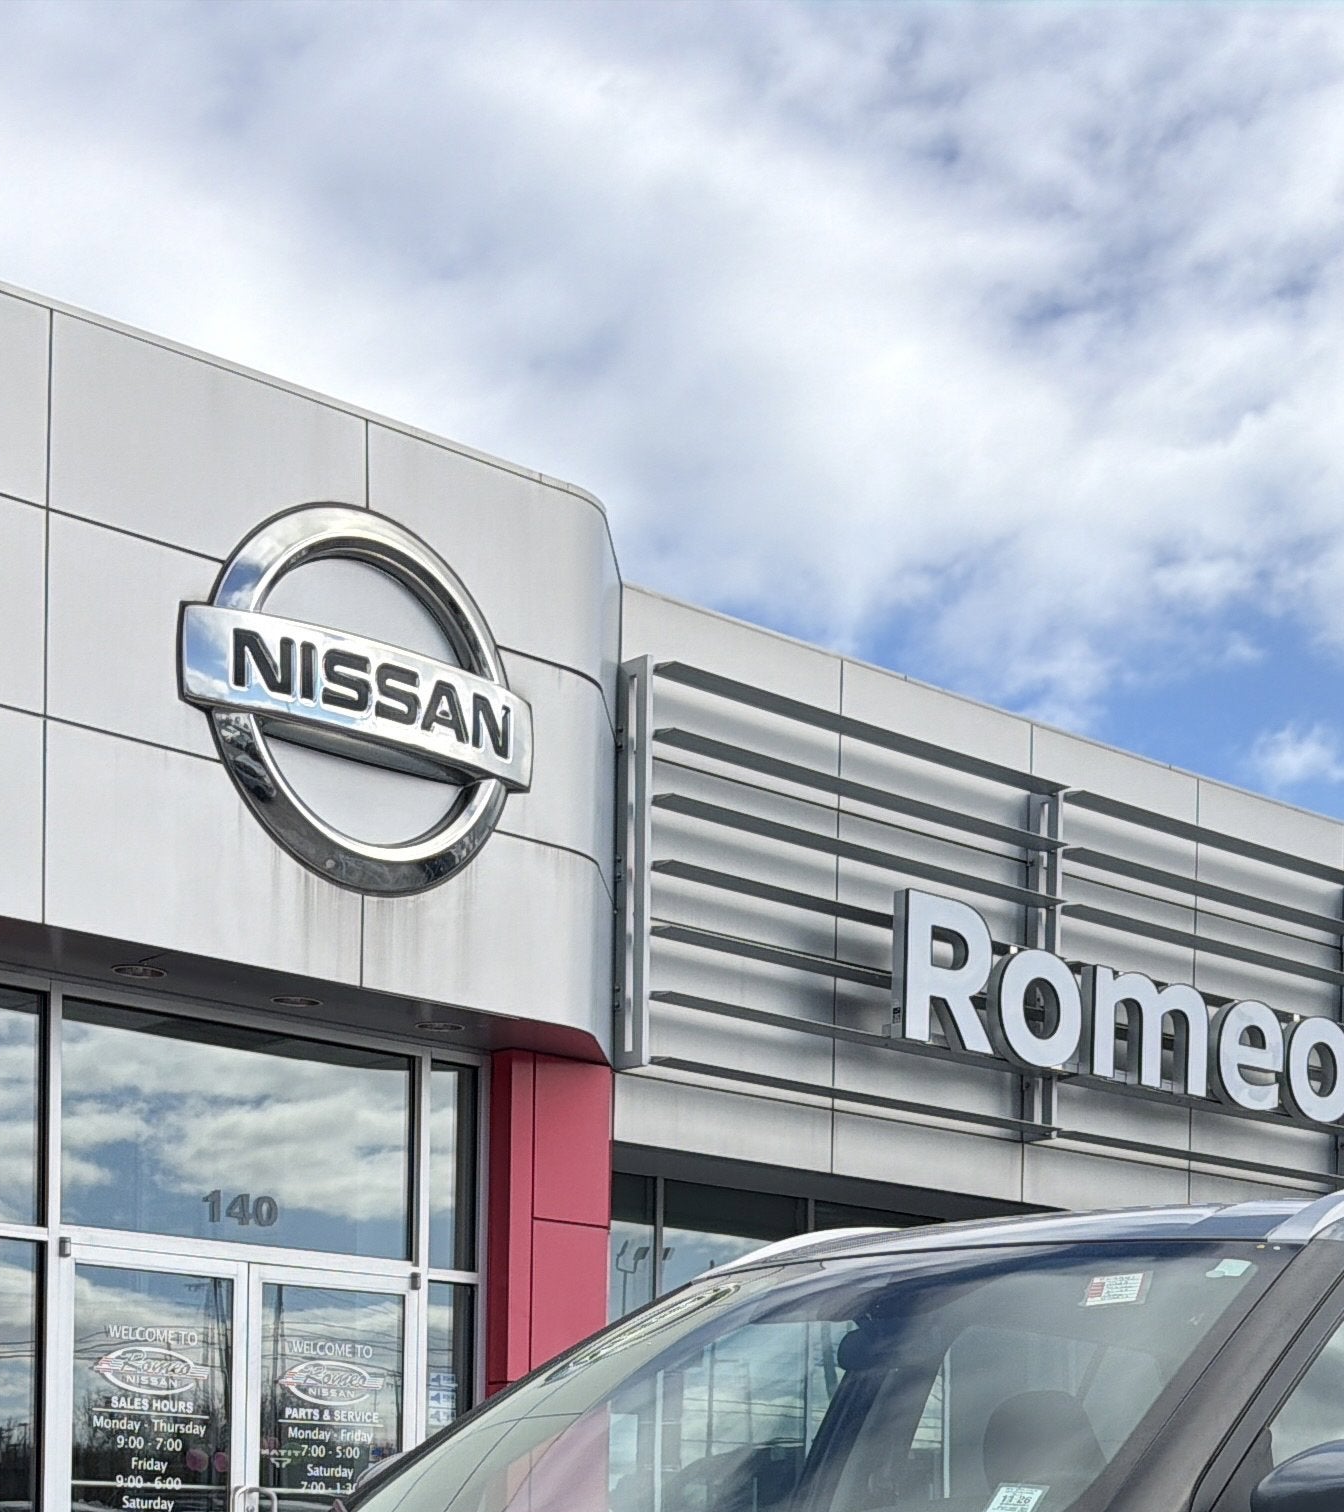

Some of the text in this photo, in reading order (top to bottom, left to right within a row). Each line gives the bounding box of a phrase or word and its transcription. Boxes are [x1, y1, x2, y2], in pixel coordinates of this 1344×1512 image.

[230, 626, 513, 763] NISSAN
[202, 1189, 278, 1227] 140
[108, 1324, 197, 1345] WELCOME TO
[291, 1340, 373, 1358] WELCOME TO
[126, 1375, 178, 1388] NISSAN
[305, 1363, 368, 1387] Romeo
[308, 1386, 356, 1399] NISSAN
[111, 1395, 194, 1413] SALES HOURS
[285, 1406, 379, 1424] PARTS & SERVICE
[92, 1415, 141, 1433] Monday
[152, 1419, 206, 1437] Thursday
[116, 1435, 144, 1450] 9:00
[156, 1438, 183, 1452] 7:00
[288, 1426, 331, 1442] Monday
[340, 1430, 374, 1445] Friday
[300, 1444, 326, 1458] 7:00
[336, 1446, 360, 1460] 5:00
[131, 1457, 168, 1473] Friday
[307, 1464, 354, 1479] Saturday
[115, 1475, 143, 1489] 9:00
[154, 1476, 182, 1491] 6:00
[300, 1481, 326, 1494] 7:00
[122, 1495, 174, 1512] Saturday
